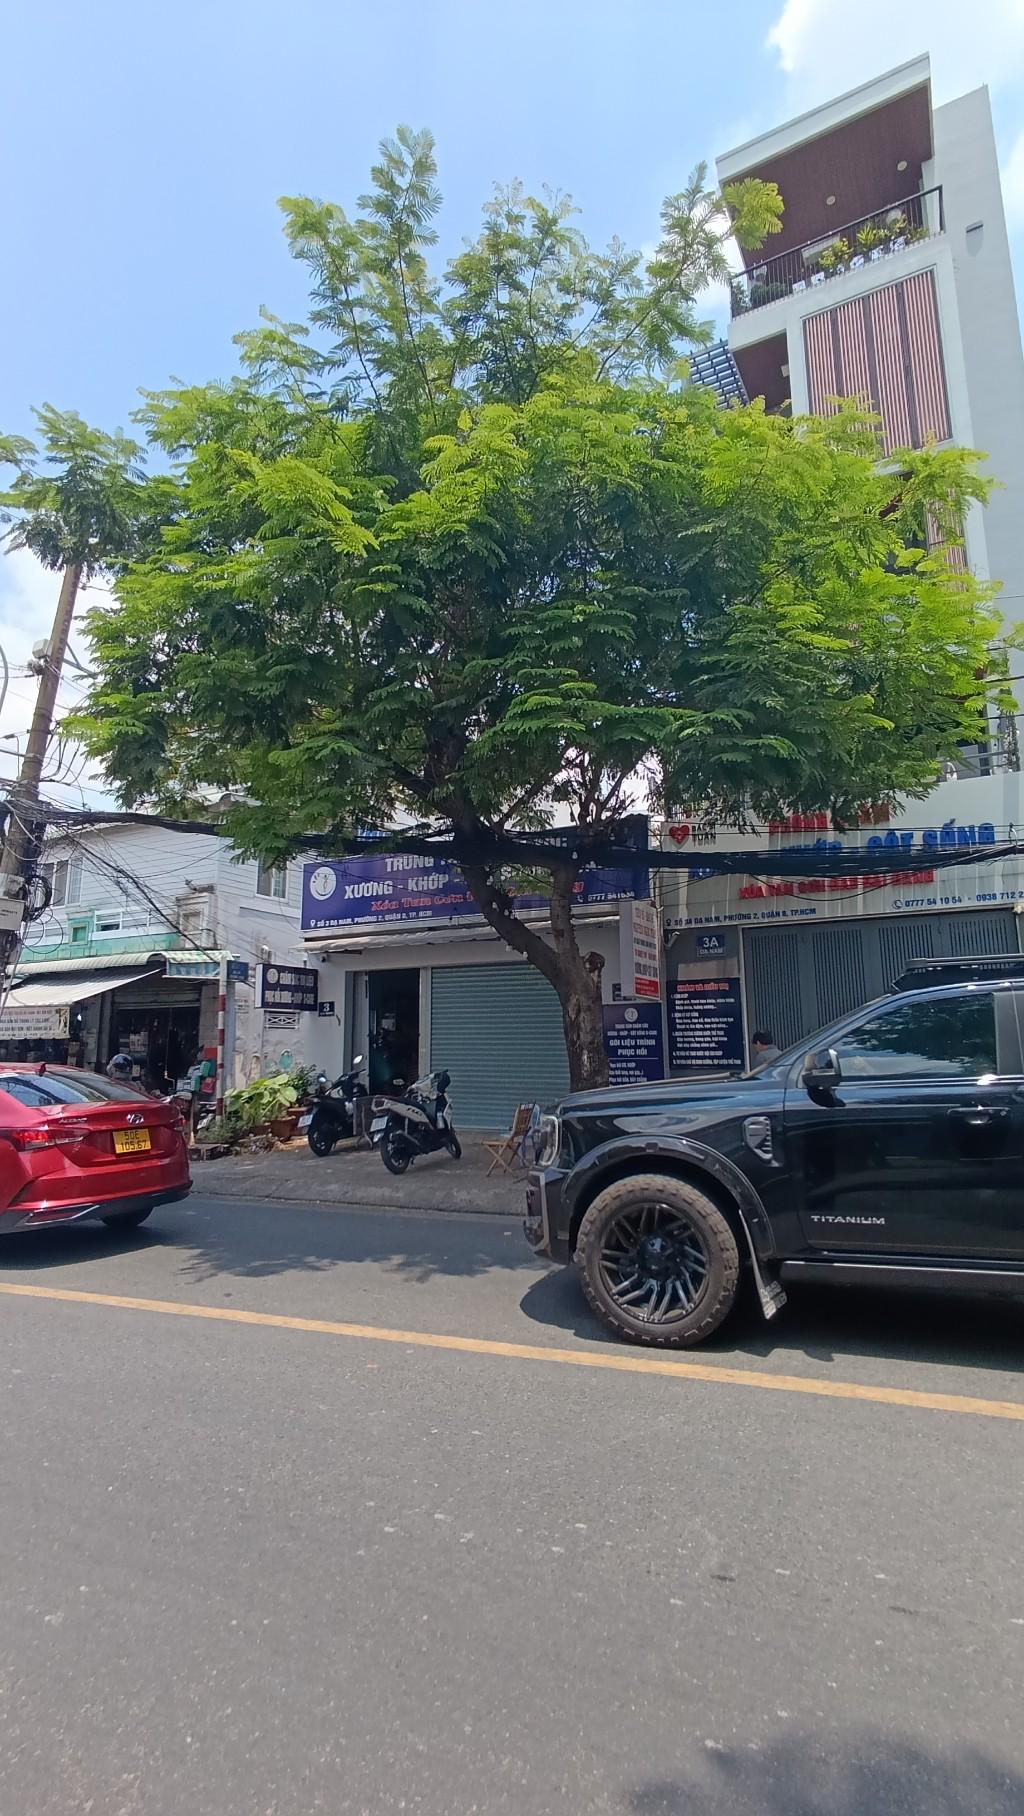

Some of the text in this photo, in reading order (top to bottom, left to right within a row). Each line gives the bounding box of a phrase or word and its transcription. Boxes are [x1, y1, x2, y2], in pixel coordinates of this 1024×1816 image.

[385, 855, 434, 872] TRUNG
[344, 880, 393, 899] XƯƠNG
[408, 871, 449, 892] KHỚP
[905, 898, 925, 907] 0777
[927, 897, 938, 906] 54
[940, 896, 950, 905] 10
[976, 893, 998, 902] 0938
[1000, 890, 1016, 900] 712
[703, 936, 719, 948] 3A
[323, 1002, 330, 1012] 3
[121, 1140, 147, 1151] 105.67
[811, 1215, 886, 1225] TITANIUM
